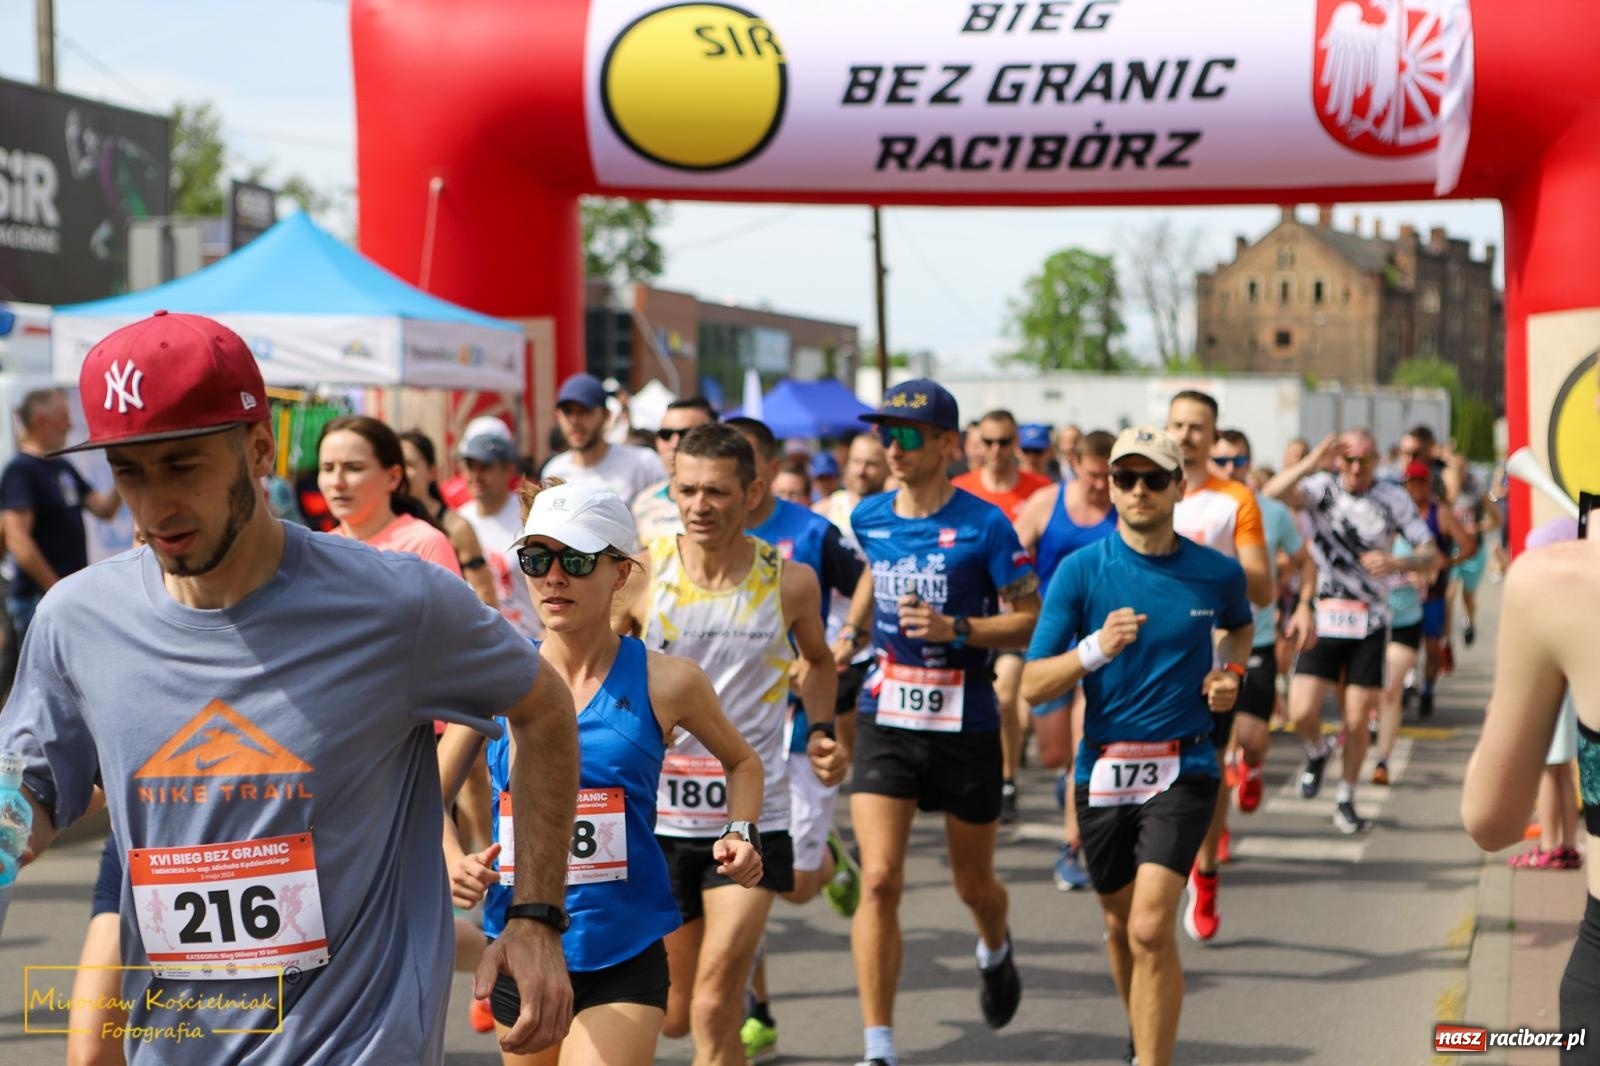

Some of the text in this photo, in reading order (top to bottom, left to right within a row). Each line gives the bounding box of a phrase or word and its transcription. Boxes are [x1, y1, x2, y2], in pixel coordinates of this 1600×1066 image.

[962, 1, 1122, 32] BIEG
[695, 25, 783, 56] SIR
[842, 58, 1237, 105] BEZ GRANIC
[875, 120, 1204, 171] RACIBÓRZ
[103, 358, 145, 414] NY
[899, 686, 944, 713] 199
[1111, 762, 1159, 787] 173
[137, 782, 315, 804] NIKE TRAIL
[577, 792, 608, 802] RANIC
[667, 779, 726, 808] 180
[148, 842, 290, 866] XVI BIEG BEZ GRANIC
[174, 885, 281, 944] 216
